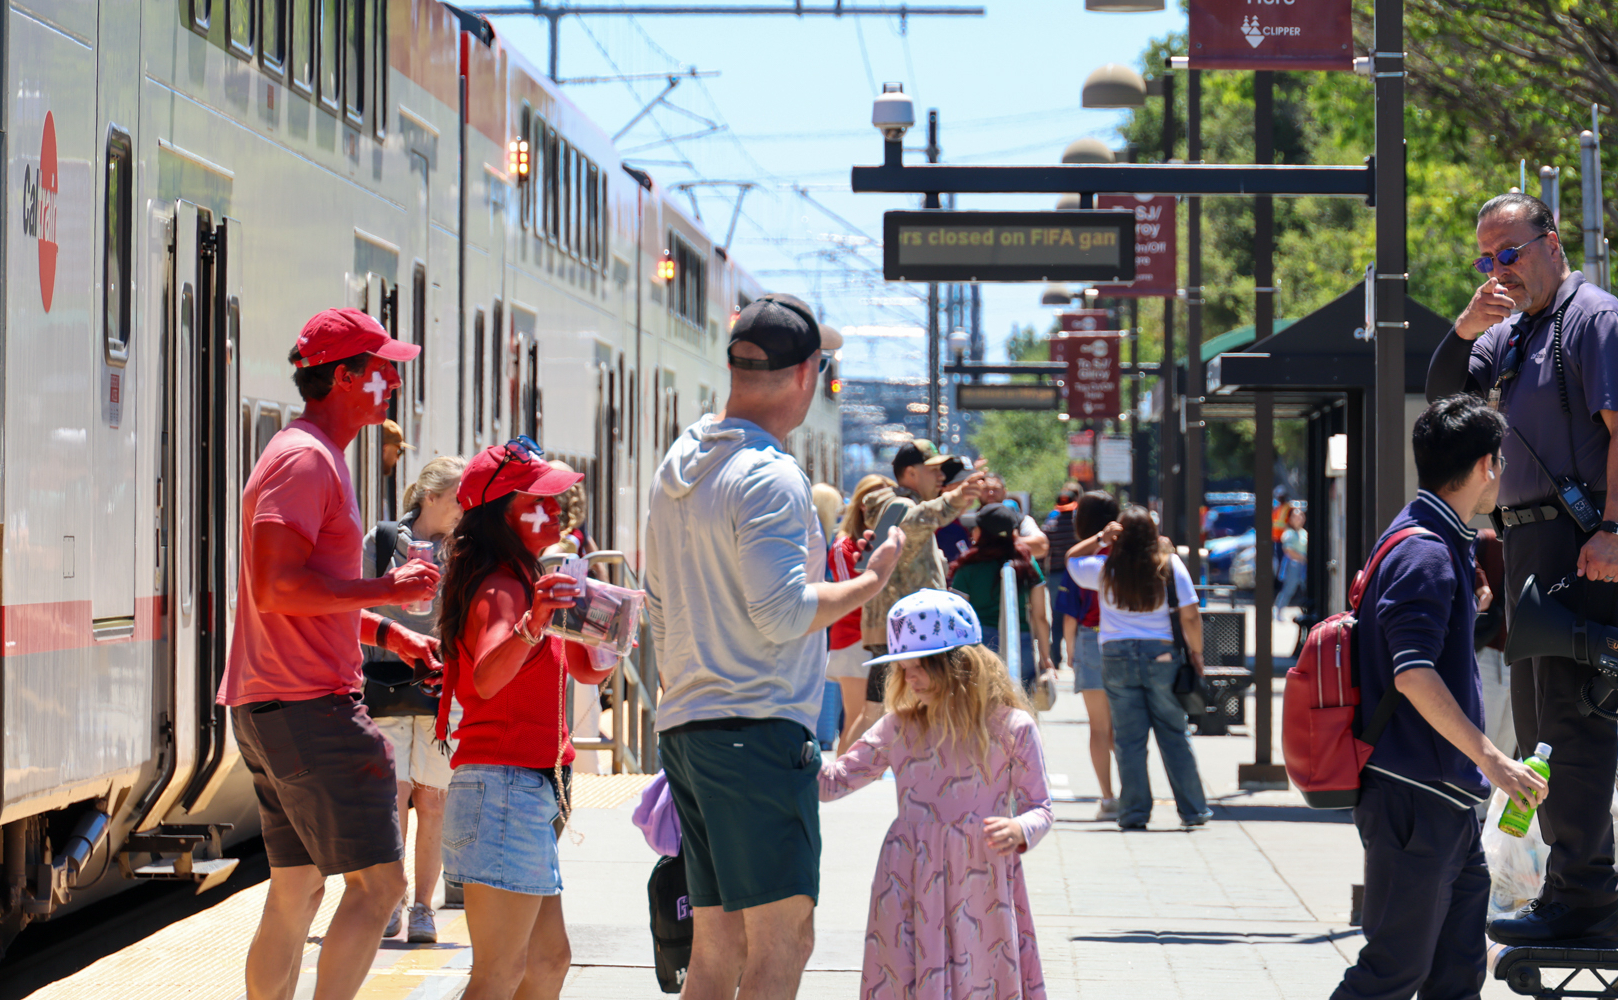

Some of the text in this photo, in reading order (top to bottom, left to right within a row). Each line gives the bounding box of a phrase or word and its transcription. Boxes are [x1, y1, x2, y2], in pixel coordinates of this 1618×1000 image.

[1262, 26, 1301, 36] CLIPPER
[23, 163, 57, 243] Caltrain
[899, 231, 922, 246] rs
[928, 228, 994, 246] closed
[1001, 231, 1025, 246] on
[1030, 229, 1075, 246] FIFA
[1135, 223, 1161, 238] roy
